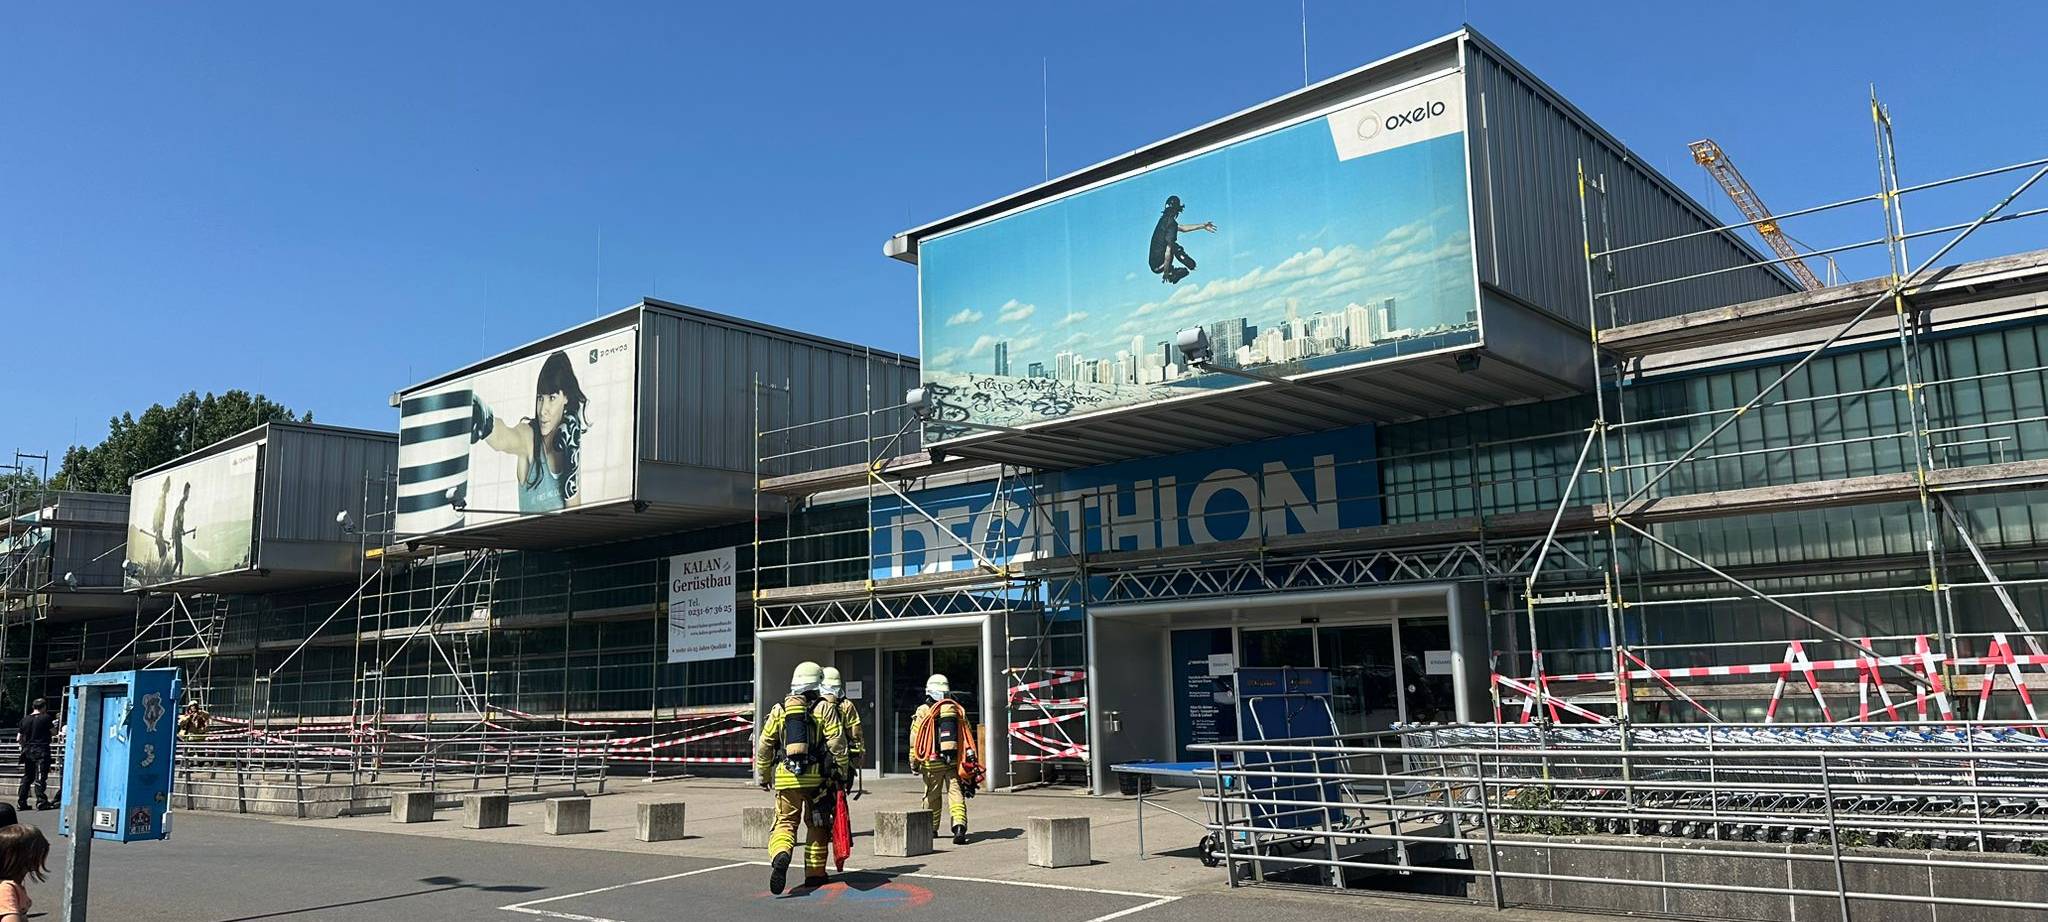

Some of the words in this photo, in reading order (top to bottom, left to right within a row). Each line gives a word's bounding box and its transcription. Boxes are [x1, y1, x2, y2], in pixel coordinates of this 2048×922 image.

[1385, 101, 1446, 130] oxelo
[683, 558, 721, 575] KALAN
[673, 574, 732, 593] Gerüstbau
